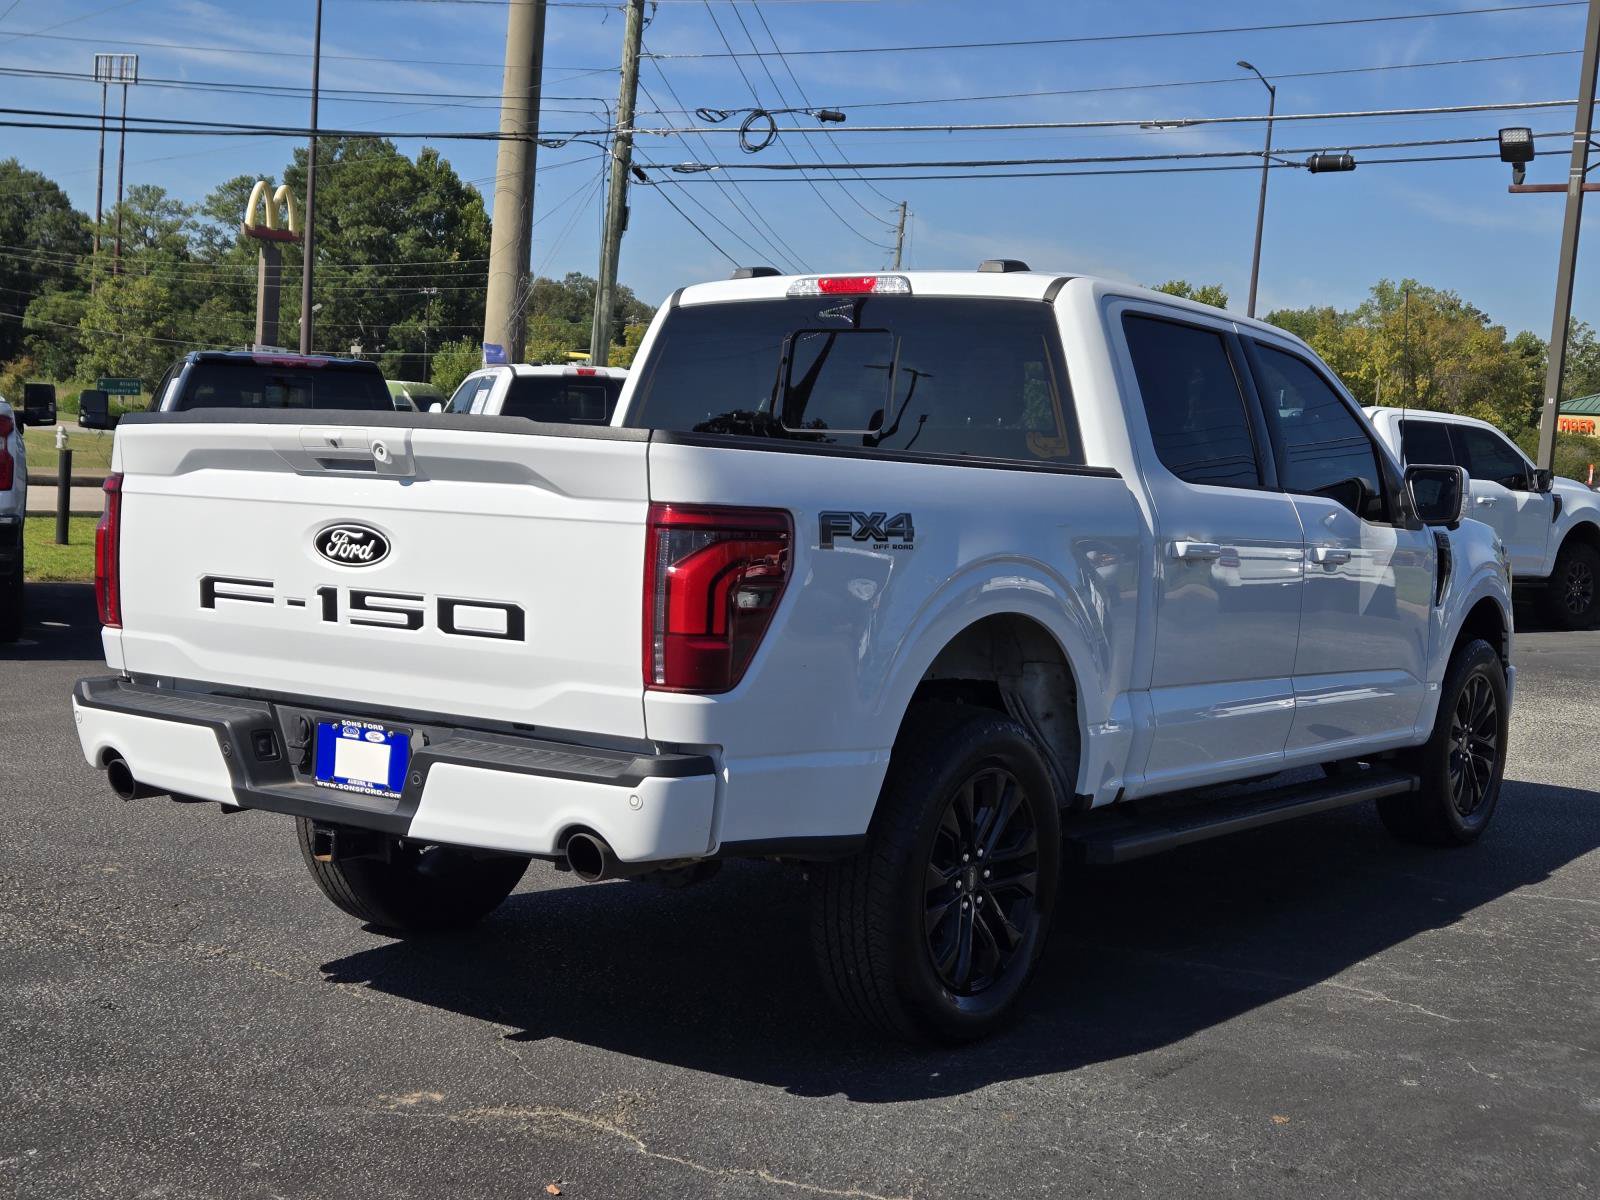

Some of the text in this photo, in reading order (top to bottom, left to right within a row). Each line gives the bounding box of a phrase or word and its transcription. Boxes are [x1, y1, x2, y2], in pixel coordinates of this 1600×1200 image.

[325, 529, 376, 560] Ford
[818, 510, 915, 550] FX4
[199, 573, 526, 642] F-150
[341, 719, 384, 731] SONS FORD
[316, 781, 402, 799] www.SONSFORD.com
